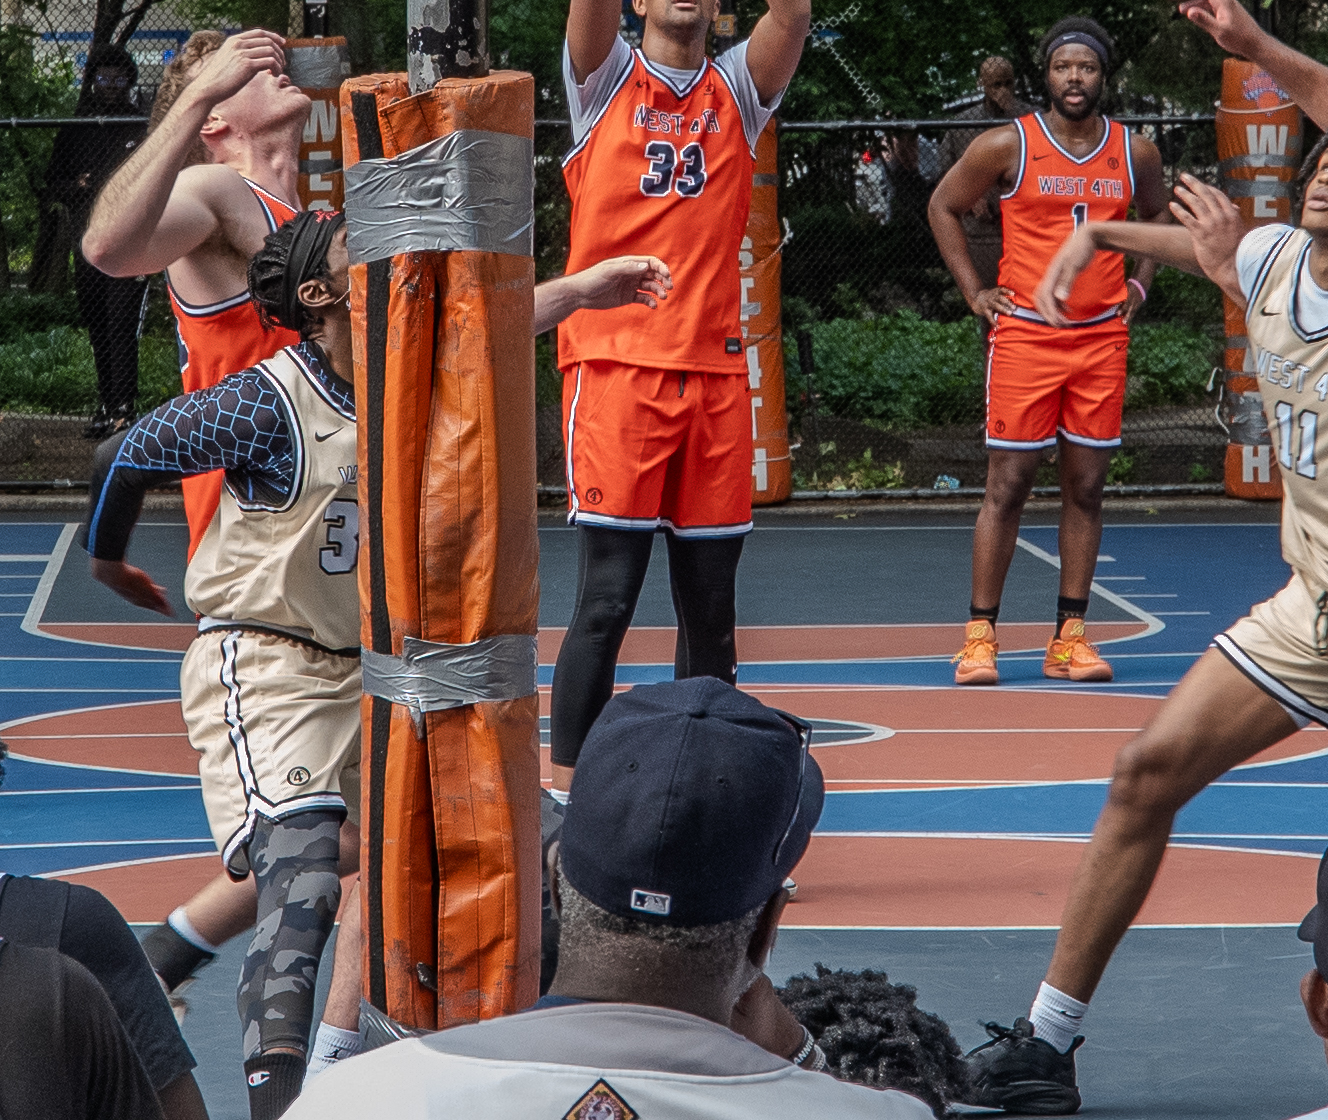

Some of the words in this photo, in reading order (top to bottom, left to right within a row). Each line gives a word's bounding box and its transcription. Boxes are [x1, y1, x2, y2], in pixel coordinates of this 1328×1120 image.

[639, 140, 708, 198] 33
[1038, 175, 1087, 196] WEST
[1090, 178, 1124, 199] 4TH
[1274, 399, 1319, 481] 11
